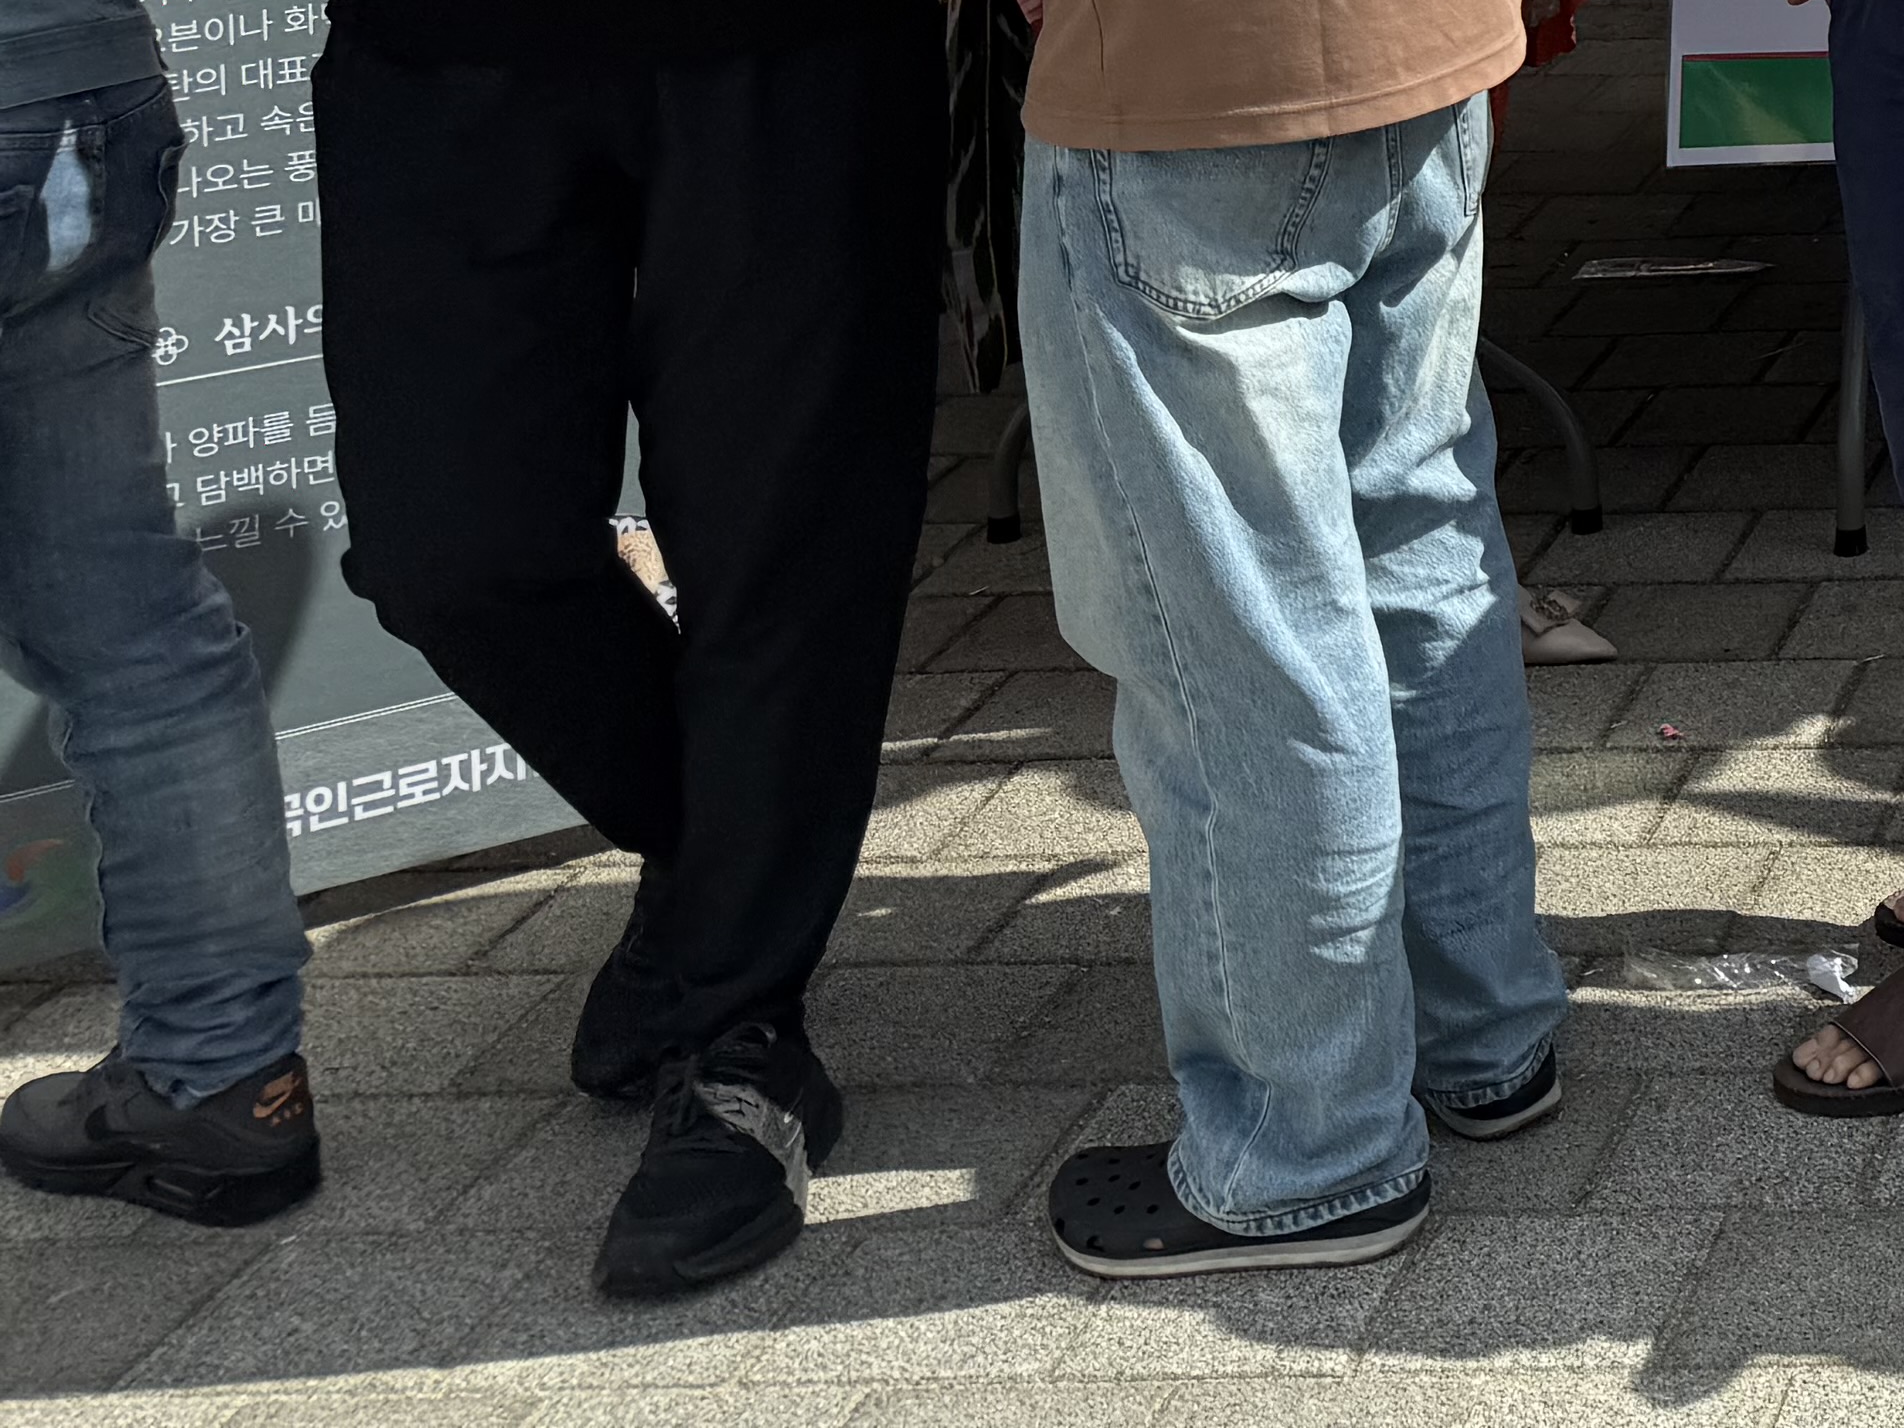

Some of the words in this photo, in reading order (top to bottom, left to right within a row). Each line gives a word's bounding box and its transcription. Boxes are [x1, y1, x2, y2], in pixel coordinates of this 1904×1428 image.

[163, 63, 226, 102] 탄의
[241, 53, 324, 91] 대표
[180, 112, 249, 148] 하고
[170, 209, 240, 248] 가장
[251, 204, 285, 238] 큰
[188, 411, 294, 458] 양파를
[196, 449, 335, 506] 담백하면
[275, 507, 309, 539] 수
